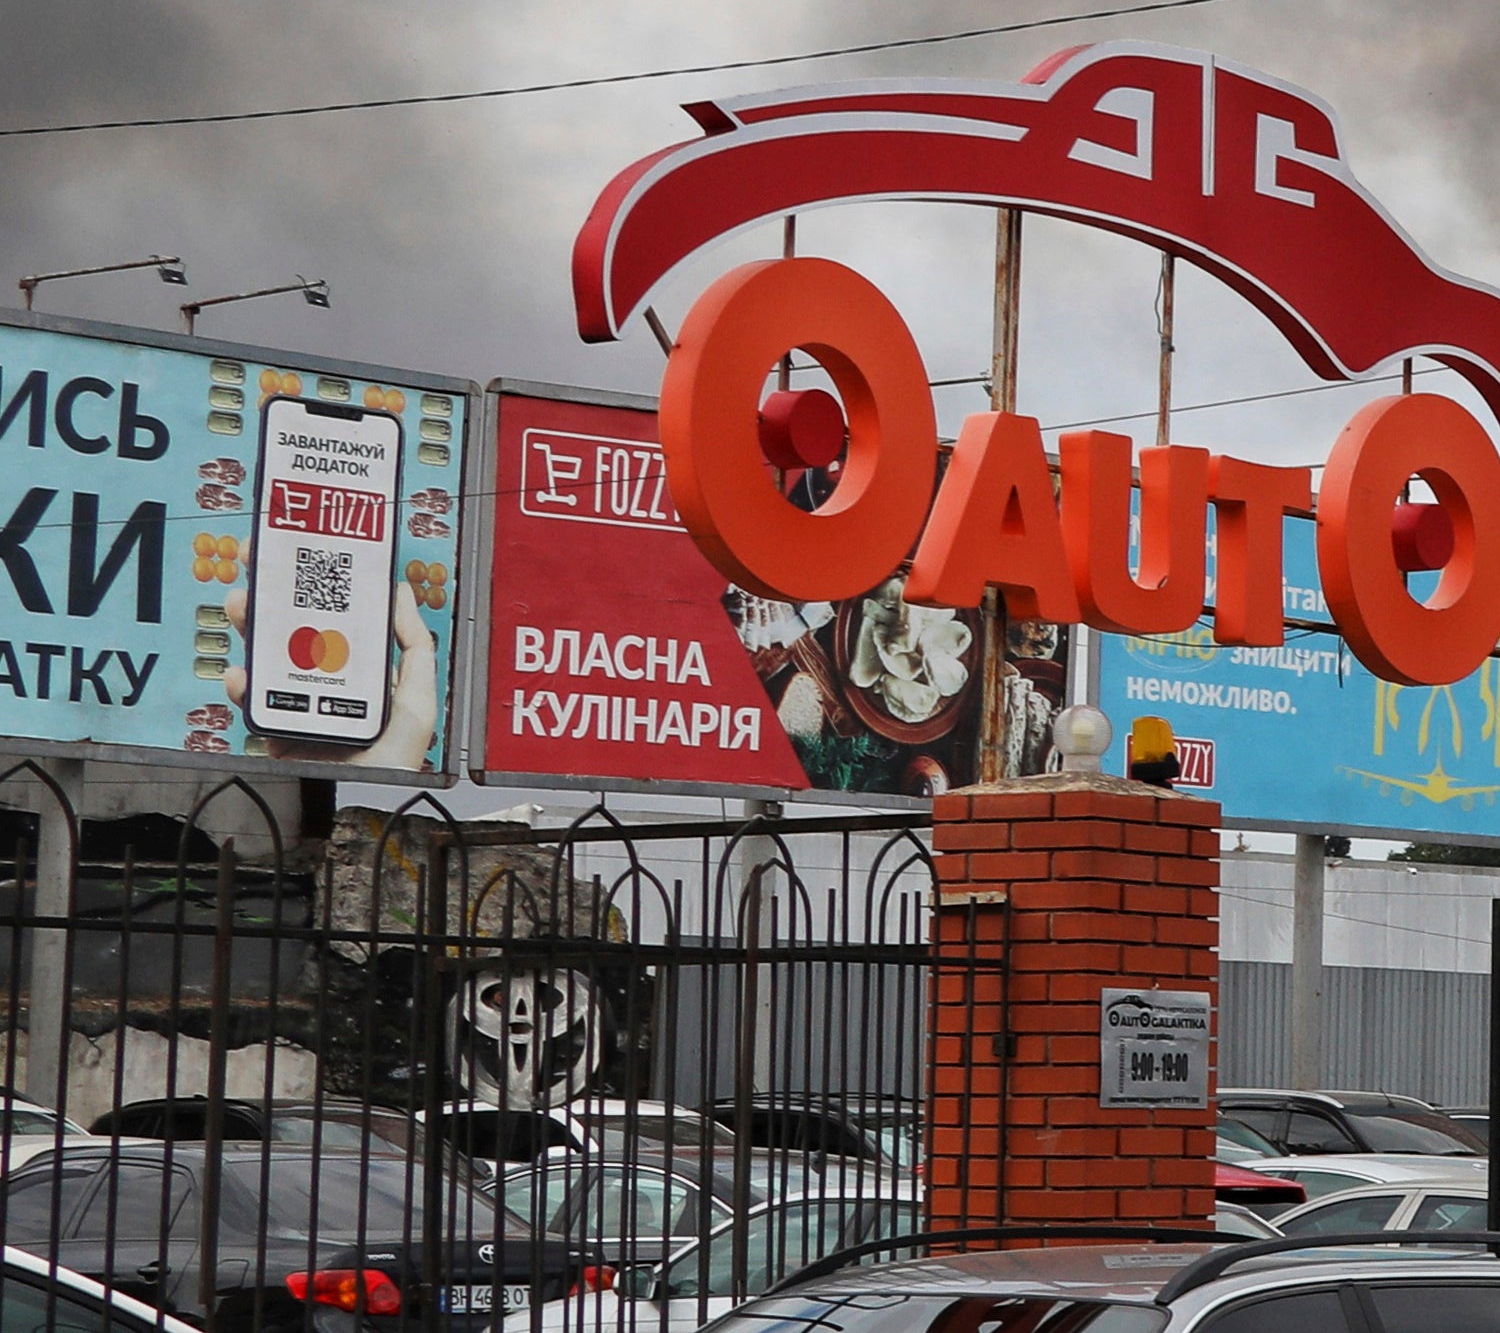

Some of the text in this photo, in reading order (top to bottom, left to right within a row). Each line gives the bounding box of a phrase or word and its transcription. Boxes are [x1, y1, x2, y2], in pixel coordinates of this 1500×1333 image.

[277, 431, 385, 461] ЗАВАНТАЖУЙ
[291, 453, 369, 478] ДОДАТОК
[594, 445, 681, 524] FOZZ
[318, 488, 384, 539] FOZZY
[287, 671, 346, 686] mastercard
[514, 625, 712, 688] ВЛАСНА
[1126, 675, 1298, 715] неможливо.
[511, 688, 761, 752] КУЛІНАРІЯ
